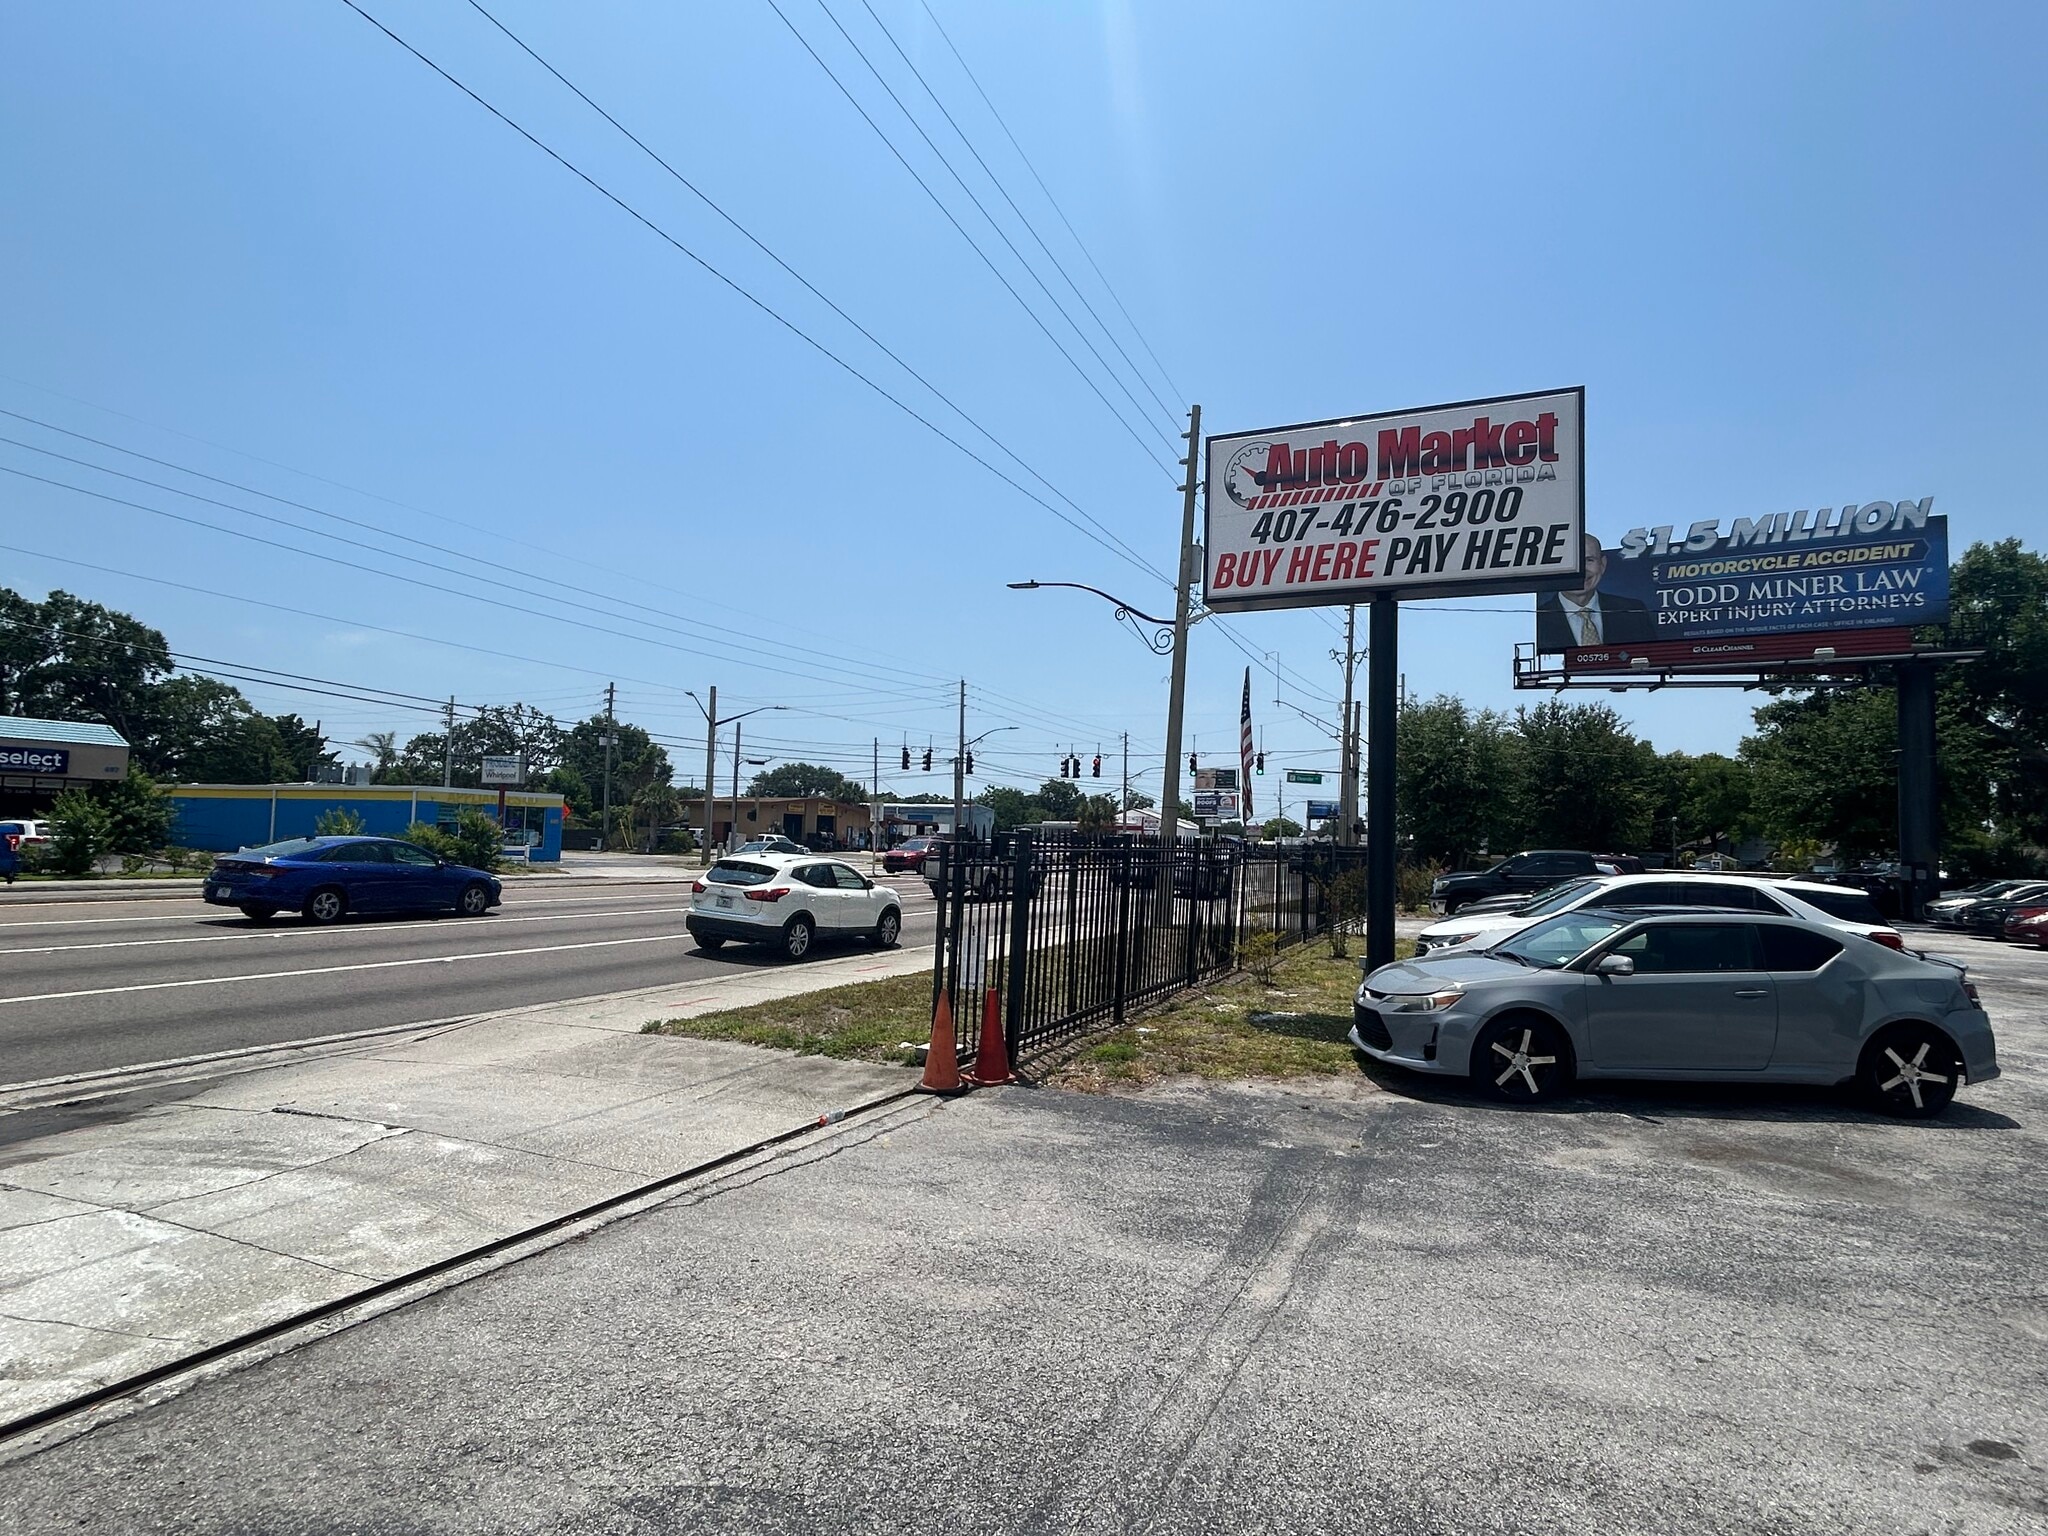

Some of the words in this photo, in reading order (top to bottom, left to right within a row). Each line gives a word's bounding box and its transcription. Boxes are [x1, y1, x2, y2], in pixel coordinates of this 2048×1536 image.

[1262, 440, 1369, 494] Auto
[1377, 411, 1559, 480] Market
[1388, 475, 1422, 496] OF
[1431, 463, 1557, 493] FLORIDA
[1250, 486, 1525, 545] 407-476-2900
[1620, 519, 1720, 559] $1.5
[1727, 497, 1934, 548] MILLION
[1212, 547, 1285, 590] BUY
[1285, 538, 1382, 584] HERE
[1383, 532, 1460, 577] PAY
[1461, 522, 1570, 571] HERE
[1666, 551, 1804, 580] MOTORCYCLE
[1805, 543, 1915, 567] ACCIDENT
[1655, 585, 1739, 609] TODD
[1747, 576, 1847, 602] MINER
[1657, 608, 1721, 626] EXPERT
[1728, 601, 1796, 623] INJURY
[1801, 592, 1926, 615] ATTORNEYS
[1576, 653, 1610, 663] 005736
[0, 750, 62, 767] select
[485, 771, 517, 780] Whirlpool
